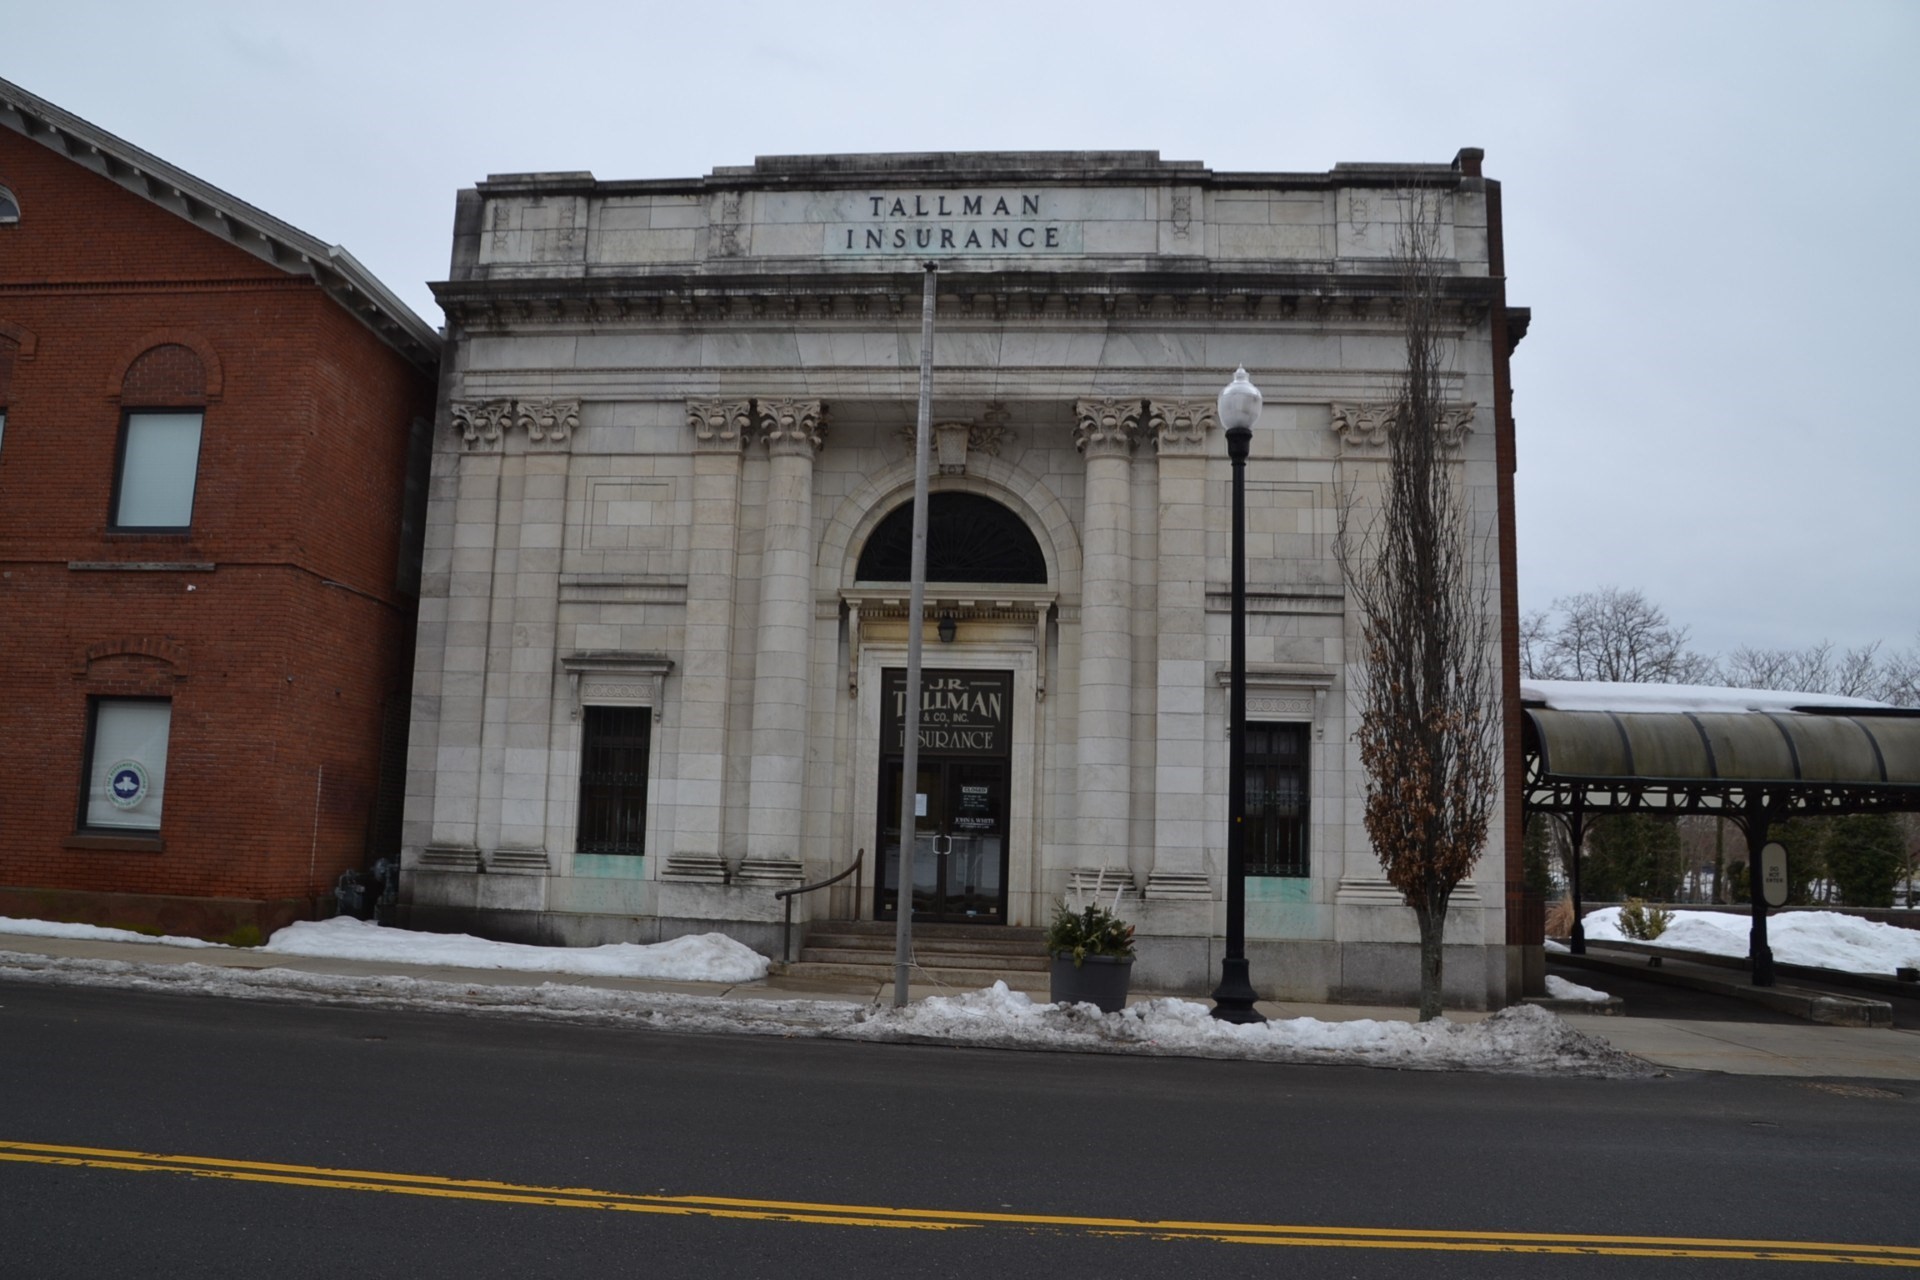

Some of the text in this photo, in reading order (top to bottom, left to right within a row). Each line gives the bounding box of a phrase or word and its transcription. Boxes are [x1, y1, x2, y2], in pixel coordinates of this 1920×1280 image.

[869, 195, 1040, 217] TALLMAN
[846, 228, 1059, 249] INSURANCE
[893, 691, 1002, 722] TLLMAN
[923, 712, 930, 722] &
[953, 713, 969, 723] INC.
[899, 730, 993, 749] ISURANCE
